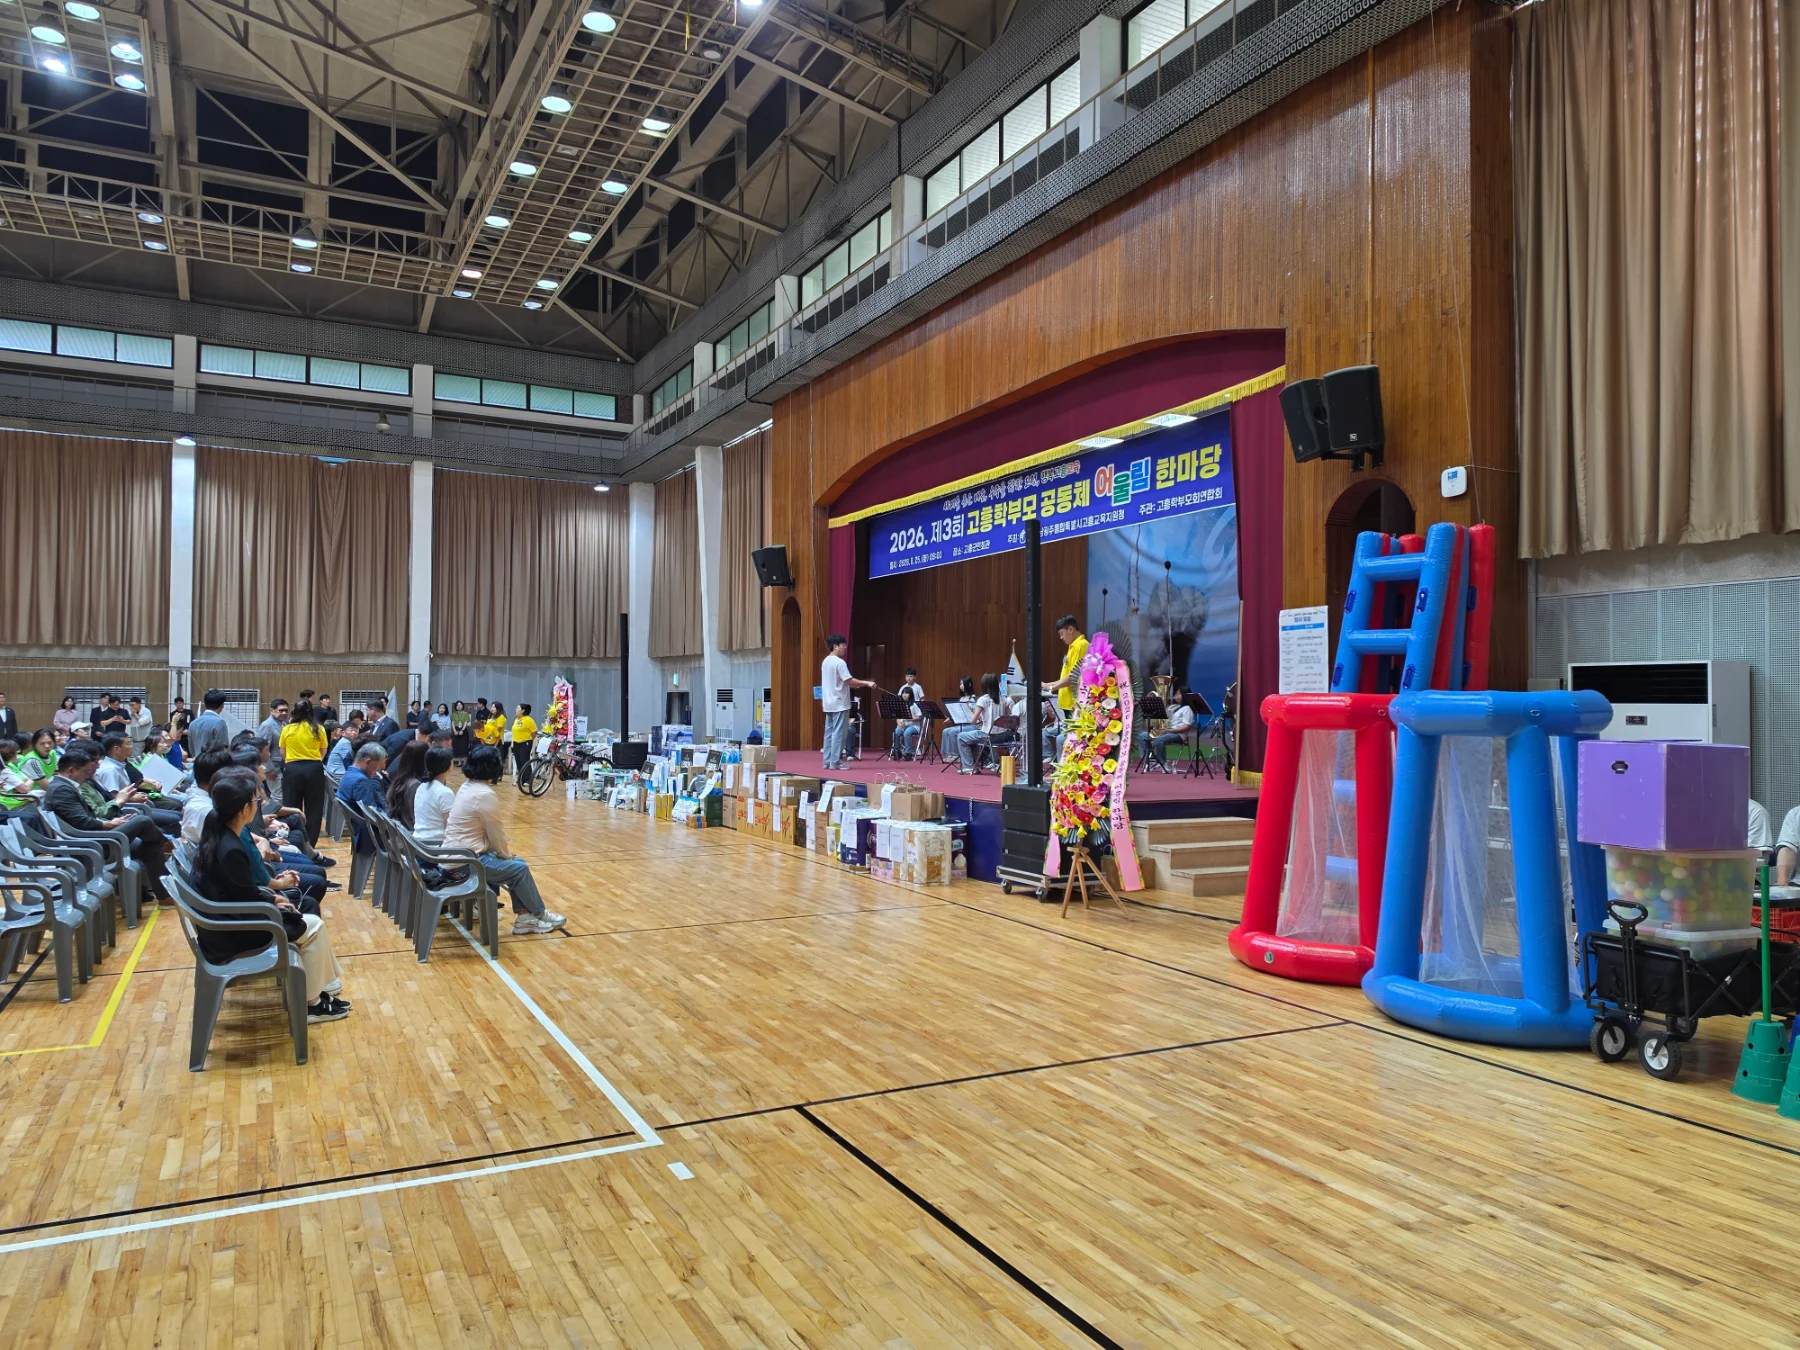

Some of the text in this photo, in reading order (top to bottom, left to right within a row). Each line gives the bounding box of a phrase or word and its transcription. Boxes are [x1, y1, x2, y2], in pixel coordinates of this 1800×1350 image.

[889, 443, 1223, 553] 2026. 제3회 고흥학부모 공동체 어울림 한마당
[1138, 487, 1223, 515] 주관: 고흥학부모회연합회
